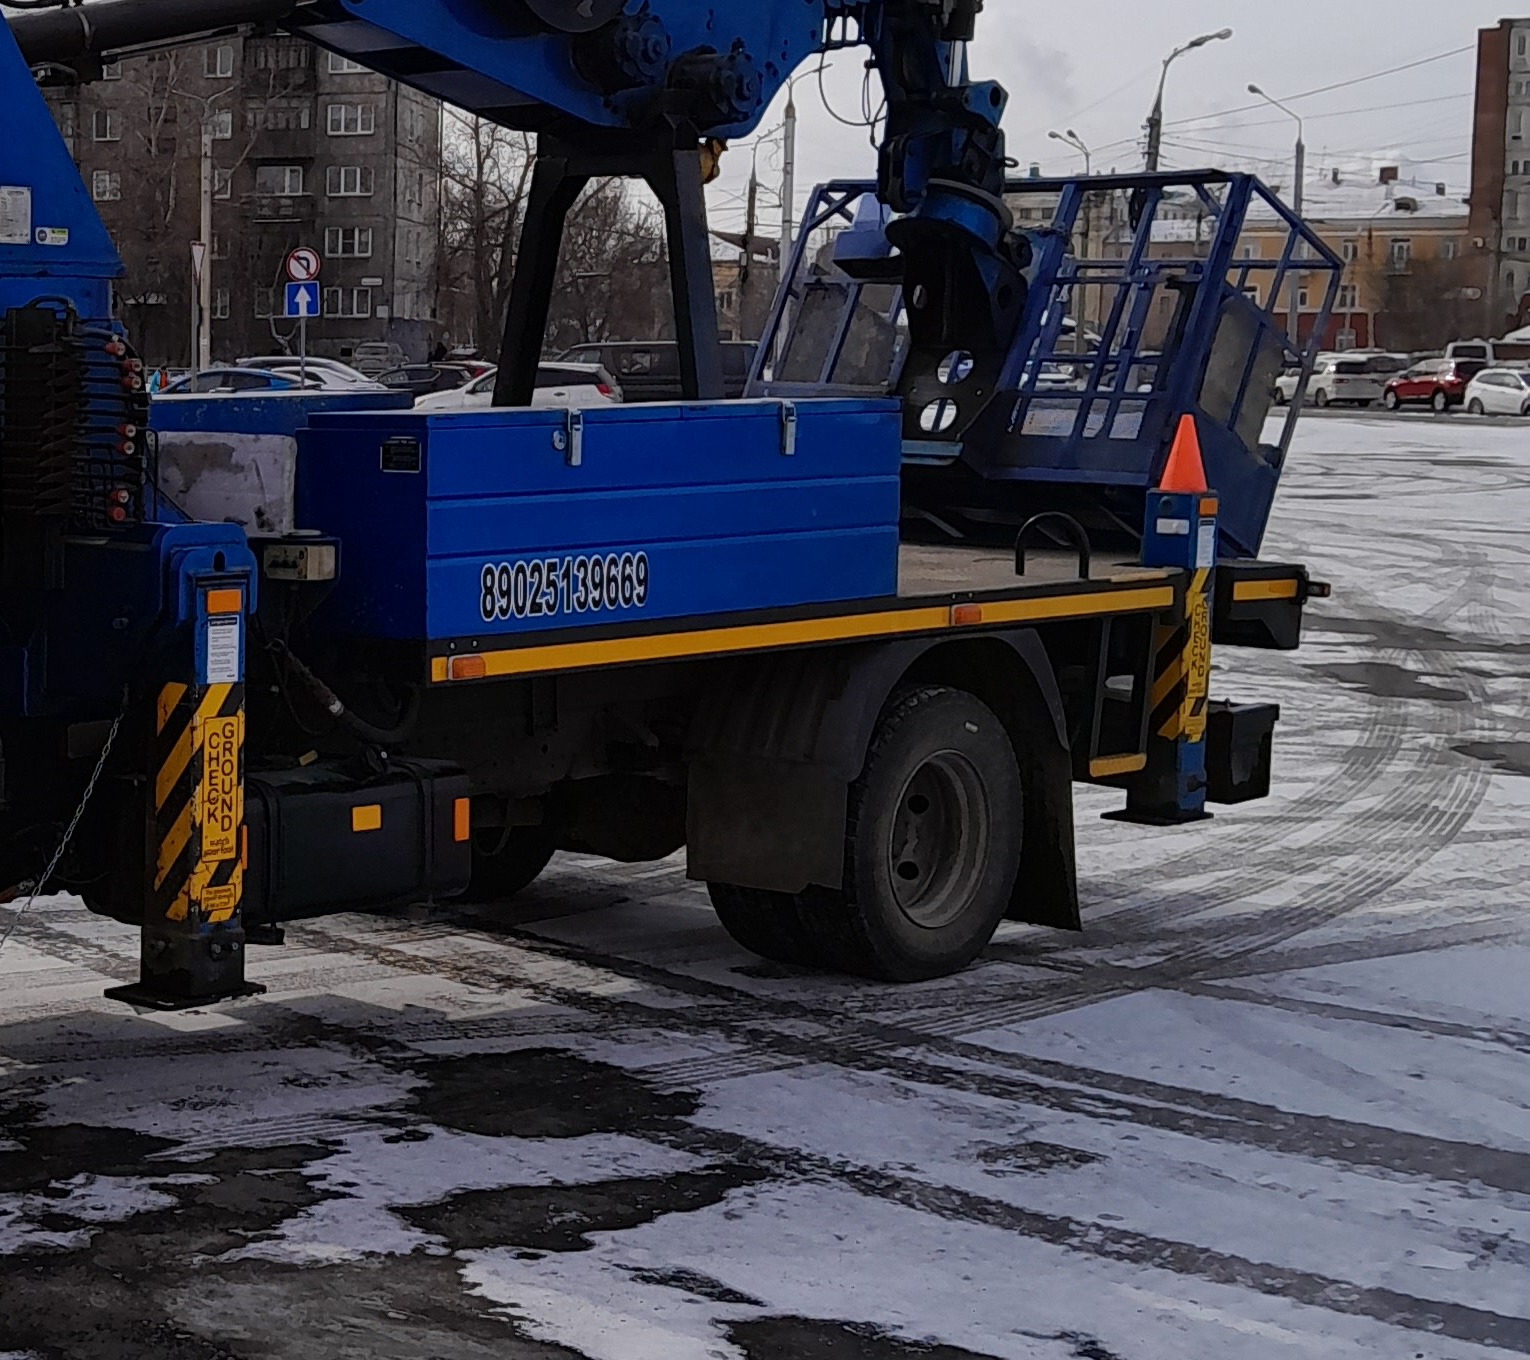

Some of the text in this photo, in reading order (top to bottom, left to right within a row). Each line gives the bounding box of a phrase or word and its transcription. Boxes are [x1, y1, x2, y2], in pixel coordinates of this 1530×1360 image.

[481, 551, 649, 622] 89025139669
[207, 732, 220, 825] CHECK
[221, 721, 235, 832] GROUND
